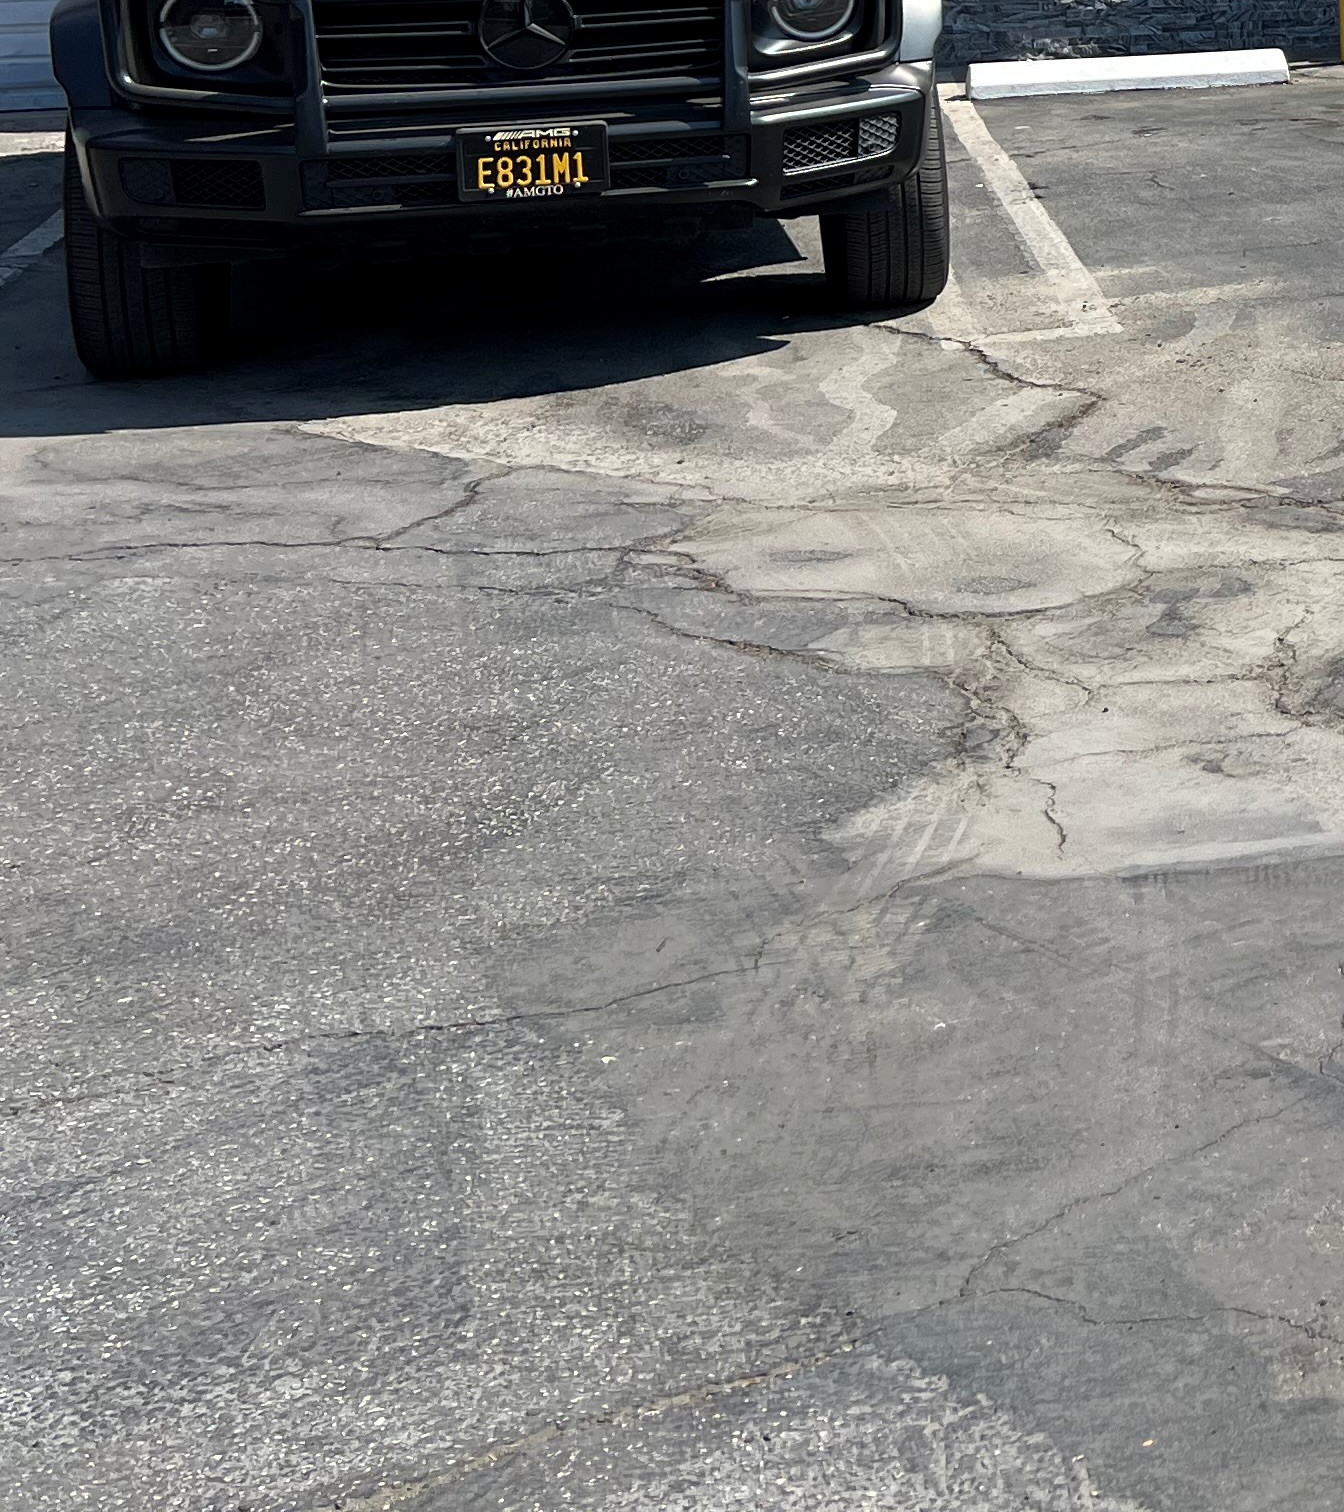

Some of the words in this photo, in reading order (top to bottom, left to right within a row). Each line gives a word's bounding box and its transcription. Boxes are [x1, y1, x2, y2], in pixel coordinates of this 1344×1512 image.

[520, 127, 571, 138] AMG
[494, 138, 572, 151] CALIFORNIA
[477, 151, 589, 189] E831M1
[506, 184, 564, 199] #AMGTO
